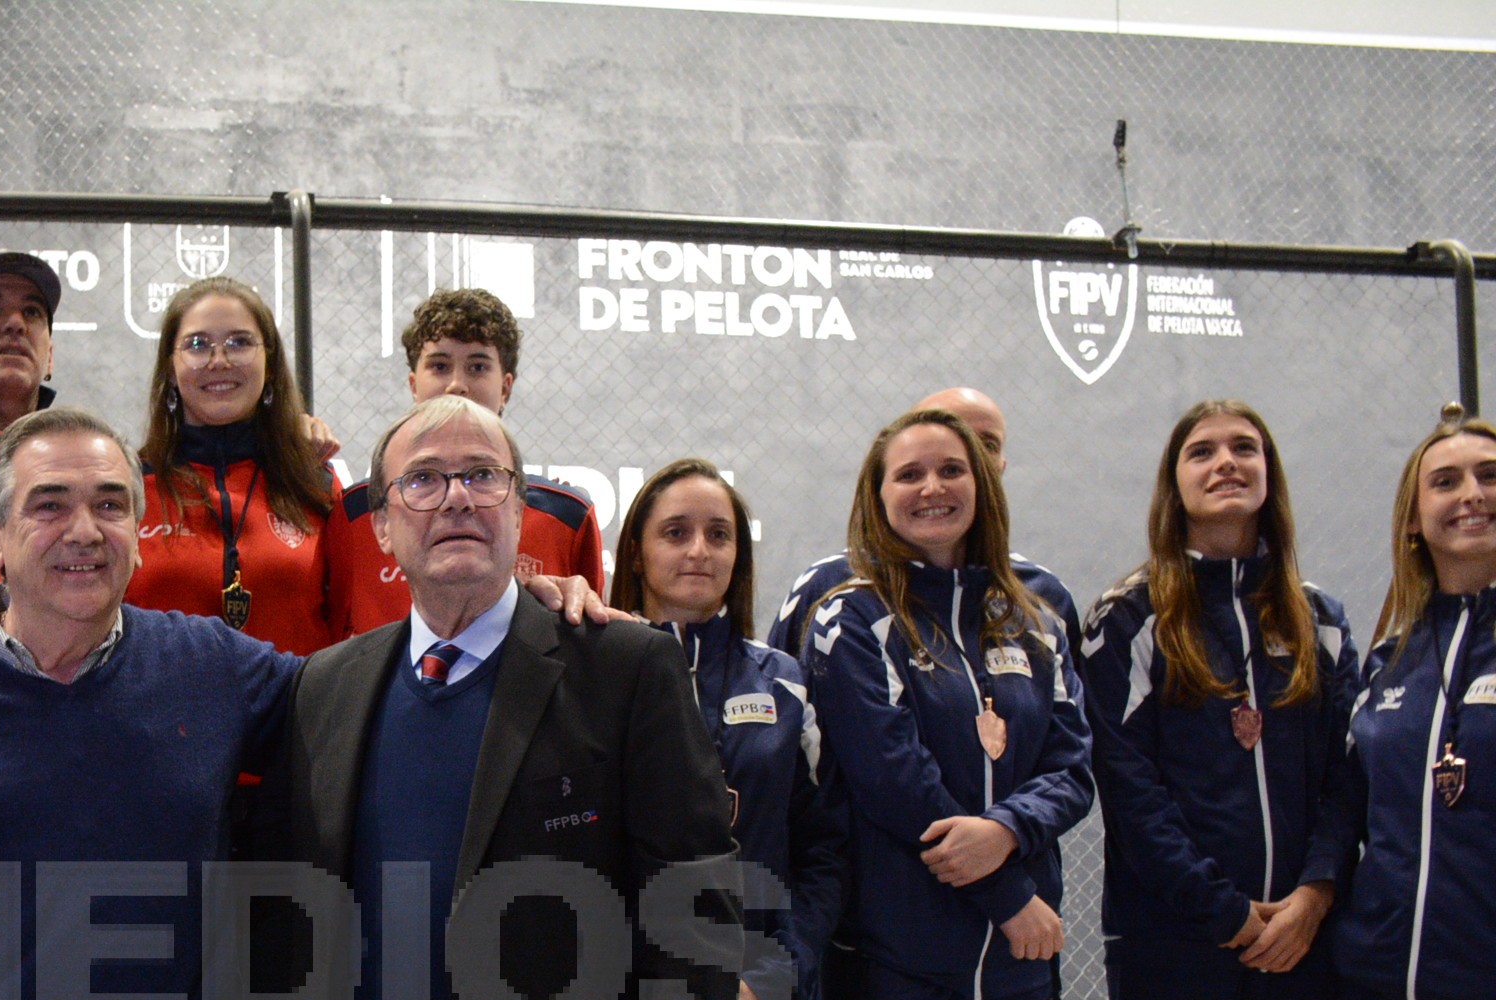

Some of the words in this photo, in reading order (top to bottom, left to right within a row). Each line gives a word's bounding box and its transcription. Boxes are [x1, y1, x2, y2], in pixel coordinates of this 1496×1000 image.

[578, 238, 832, 289] FRONTON
[840, 263, 871, 277] SAN
[874, 265, 934, 280] CARLOS
[1049, 271, 1123, 317] FIPV
[579, 286, 650, 332] DE
[661, 289, 858, 341] PELOTA
[723, 702, 759, 717] FFPB
[544, 814, 580, 832] FFPB
